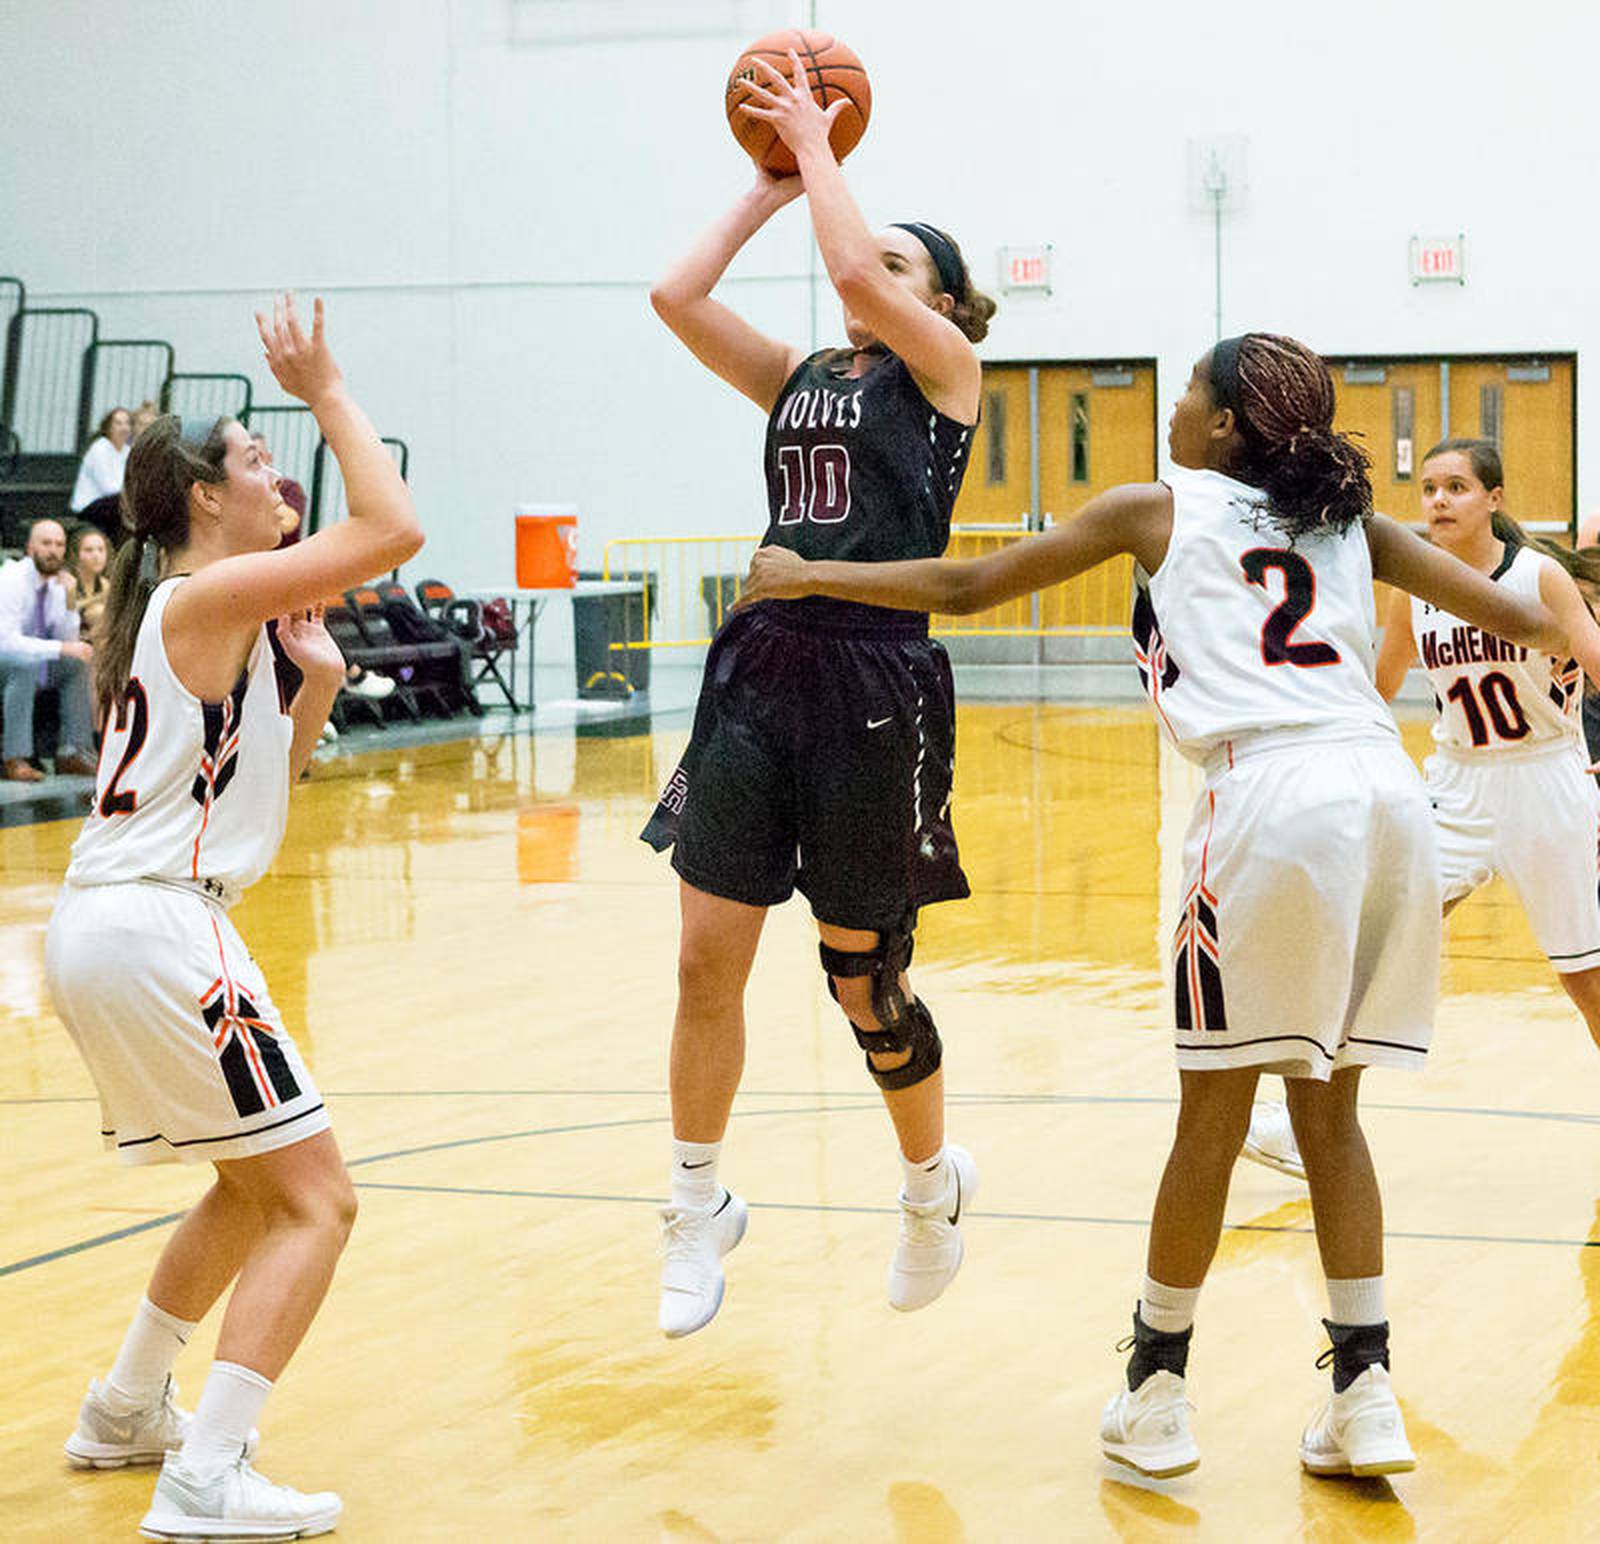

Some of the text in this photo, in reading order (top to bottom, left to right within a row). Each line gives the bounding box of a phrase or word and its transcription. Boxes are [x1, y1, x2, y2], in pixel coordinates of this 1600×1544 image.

[1010, 257, 1045, 283] EXIT
[1421, 248, 1455, 273] EXIT
[778, 445, 851, 525] 10
[1239, 546, 1342, 668] 2
[1447, 671, 1531, 748] 10
